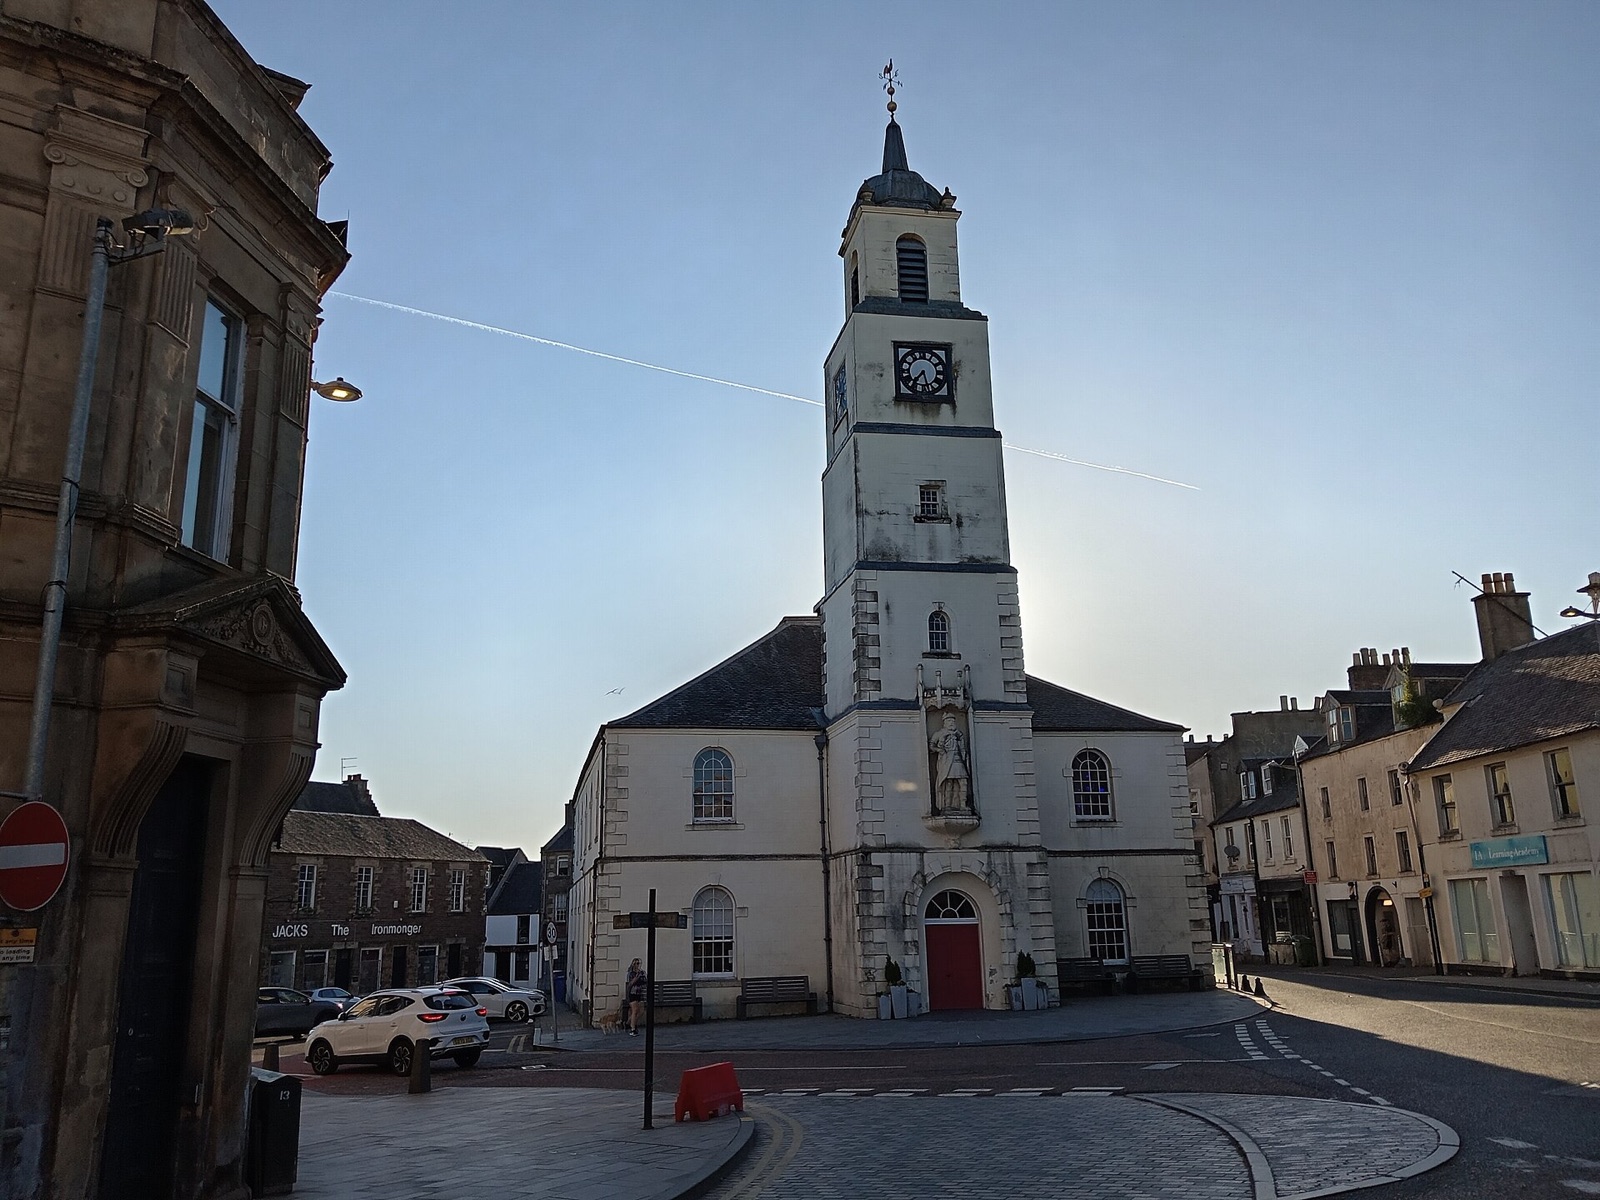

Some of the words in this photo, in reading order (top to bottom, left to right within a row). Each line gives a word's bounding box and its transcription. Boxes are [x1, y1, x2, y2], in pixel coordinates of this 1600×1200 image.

[272, 924, 308, 938] JACKS
[331, 924, 350, 936] The
[371, 923, 422, 936] Ironmonger
[547, 927, 555, 938] 30
[279, 1090, 290, 1101] 13
